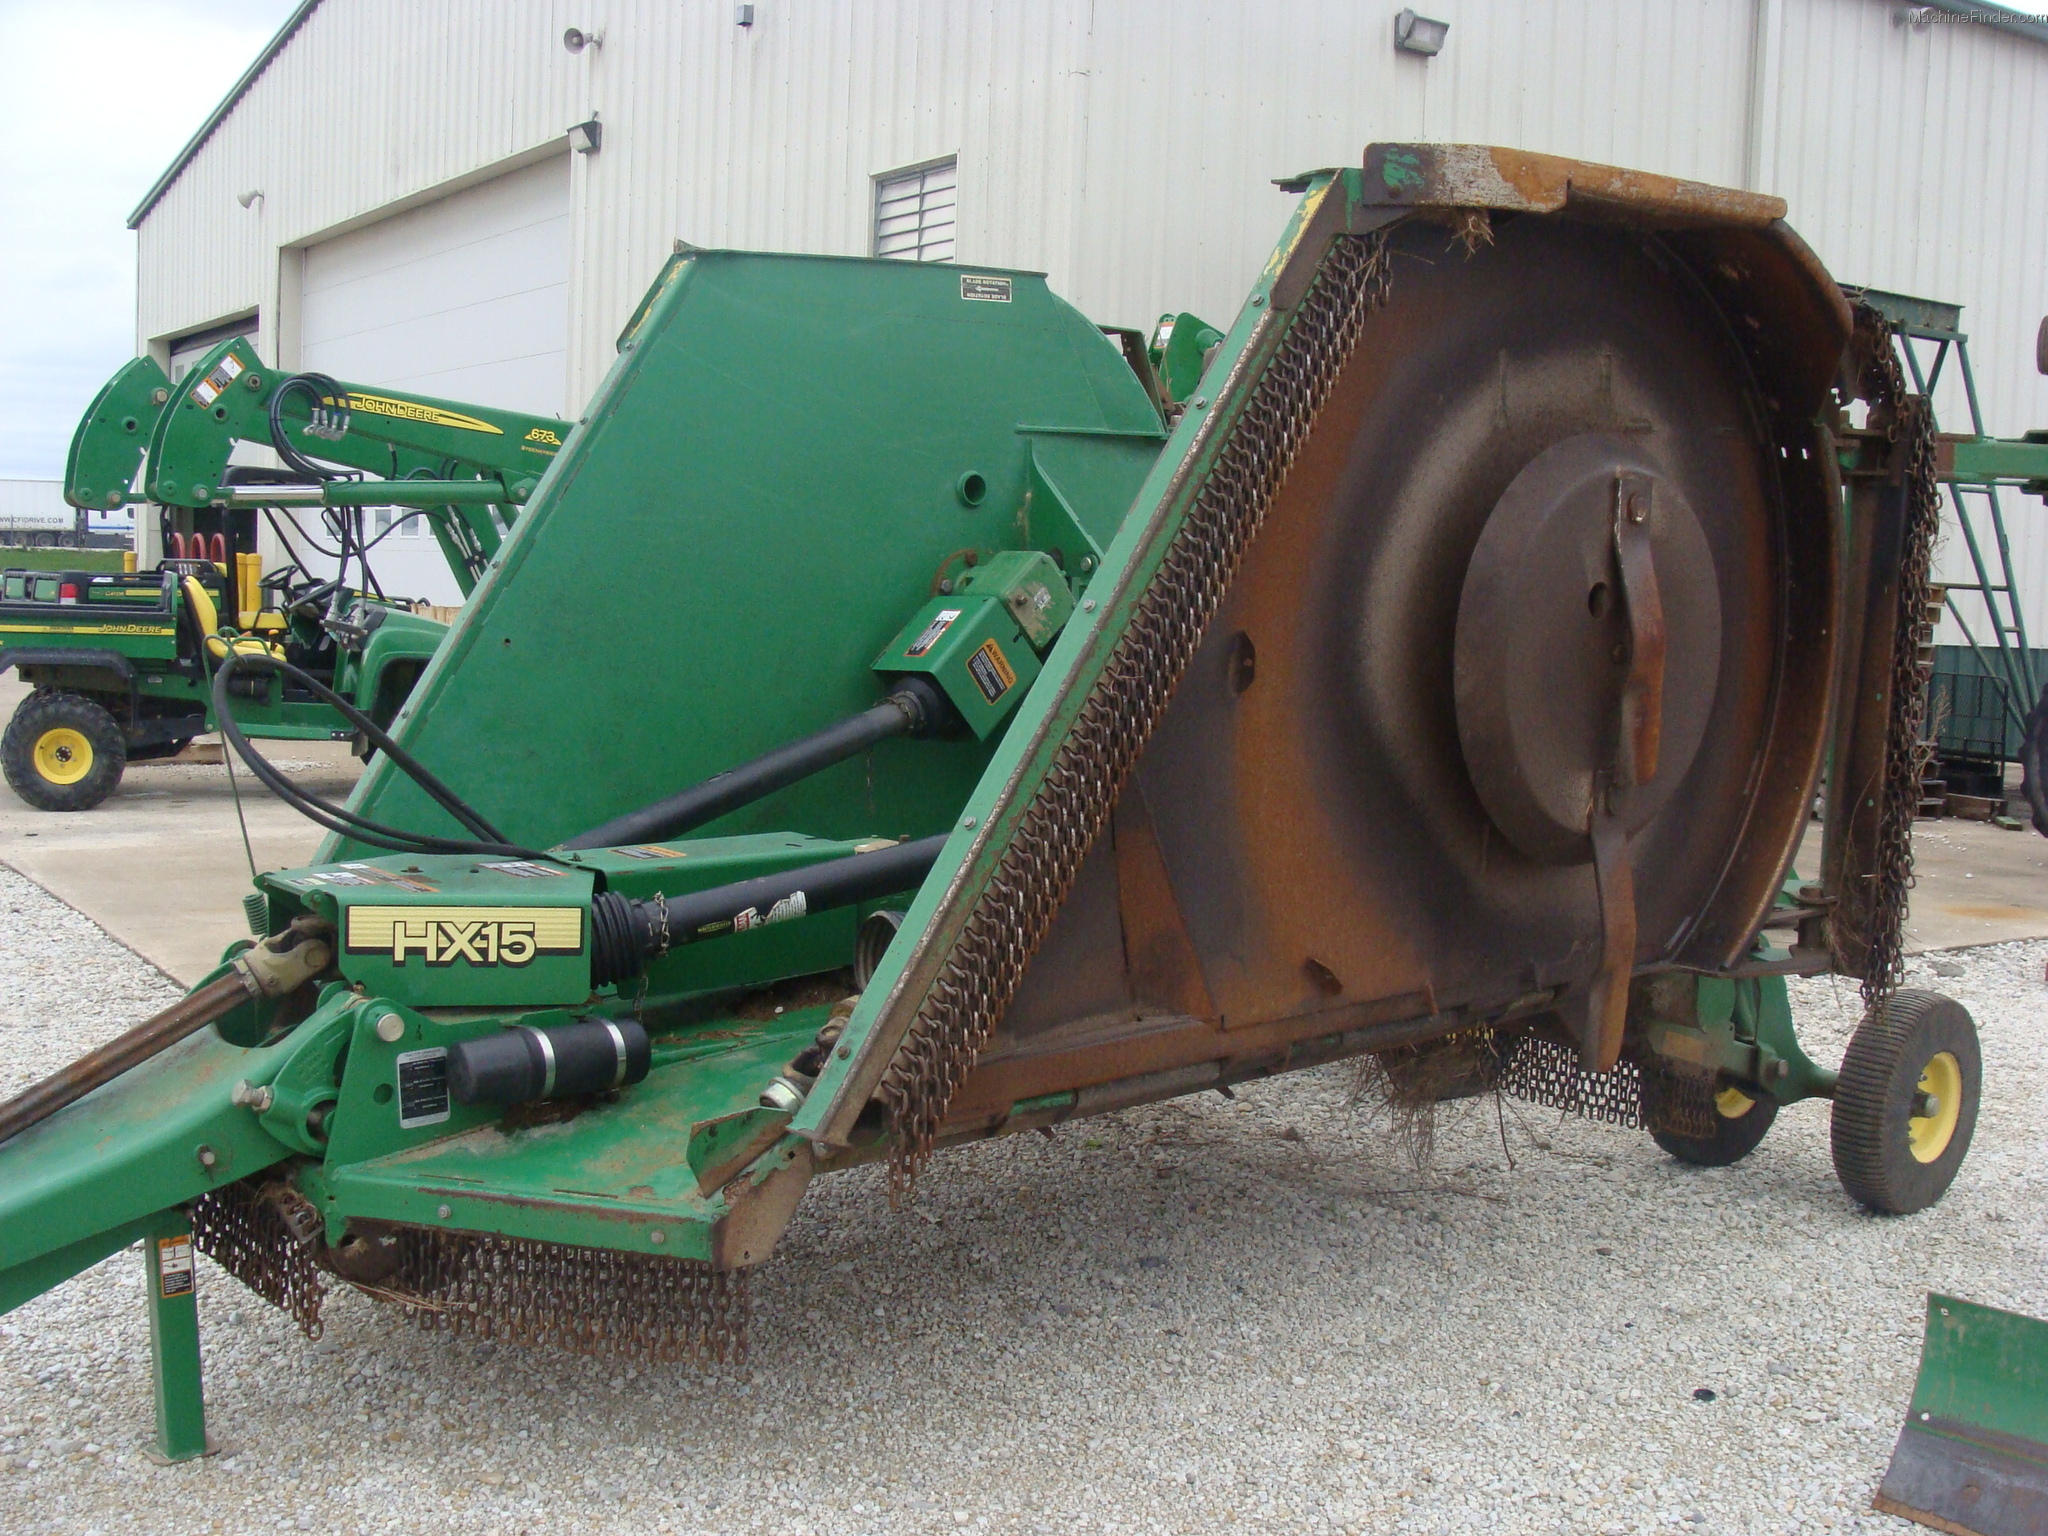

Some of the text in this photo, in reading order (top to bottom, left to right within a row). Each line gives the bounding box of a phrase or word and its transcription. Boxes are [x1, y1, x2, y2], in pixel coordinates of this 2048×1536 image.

[531, 428, 556, 443] 673
[990, 648, 1014, 685] WARNING
[393, 921, 537, 967] HX15
